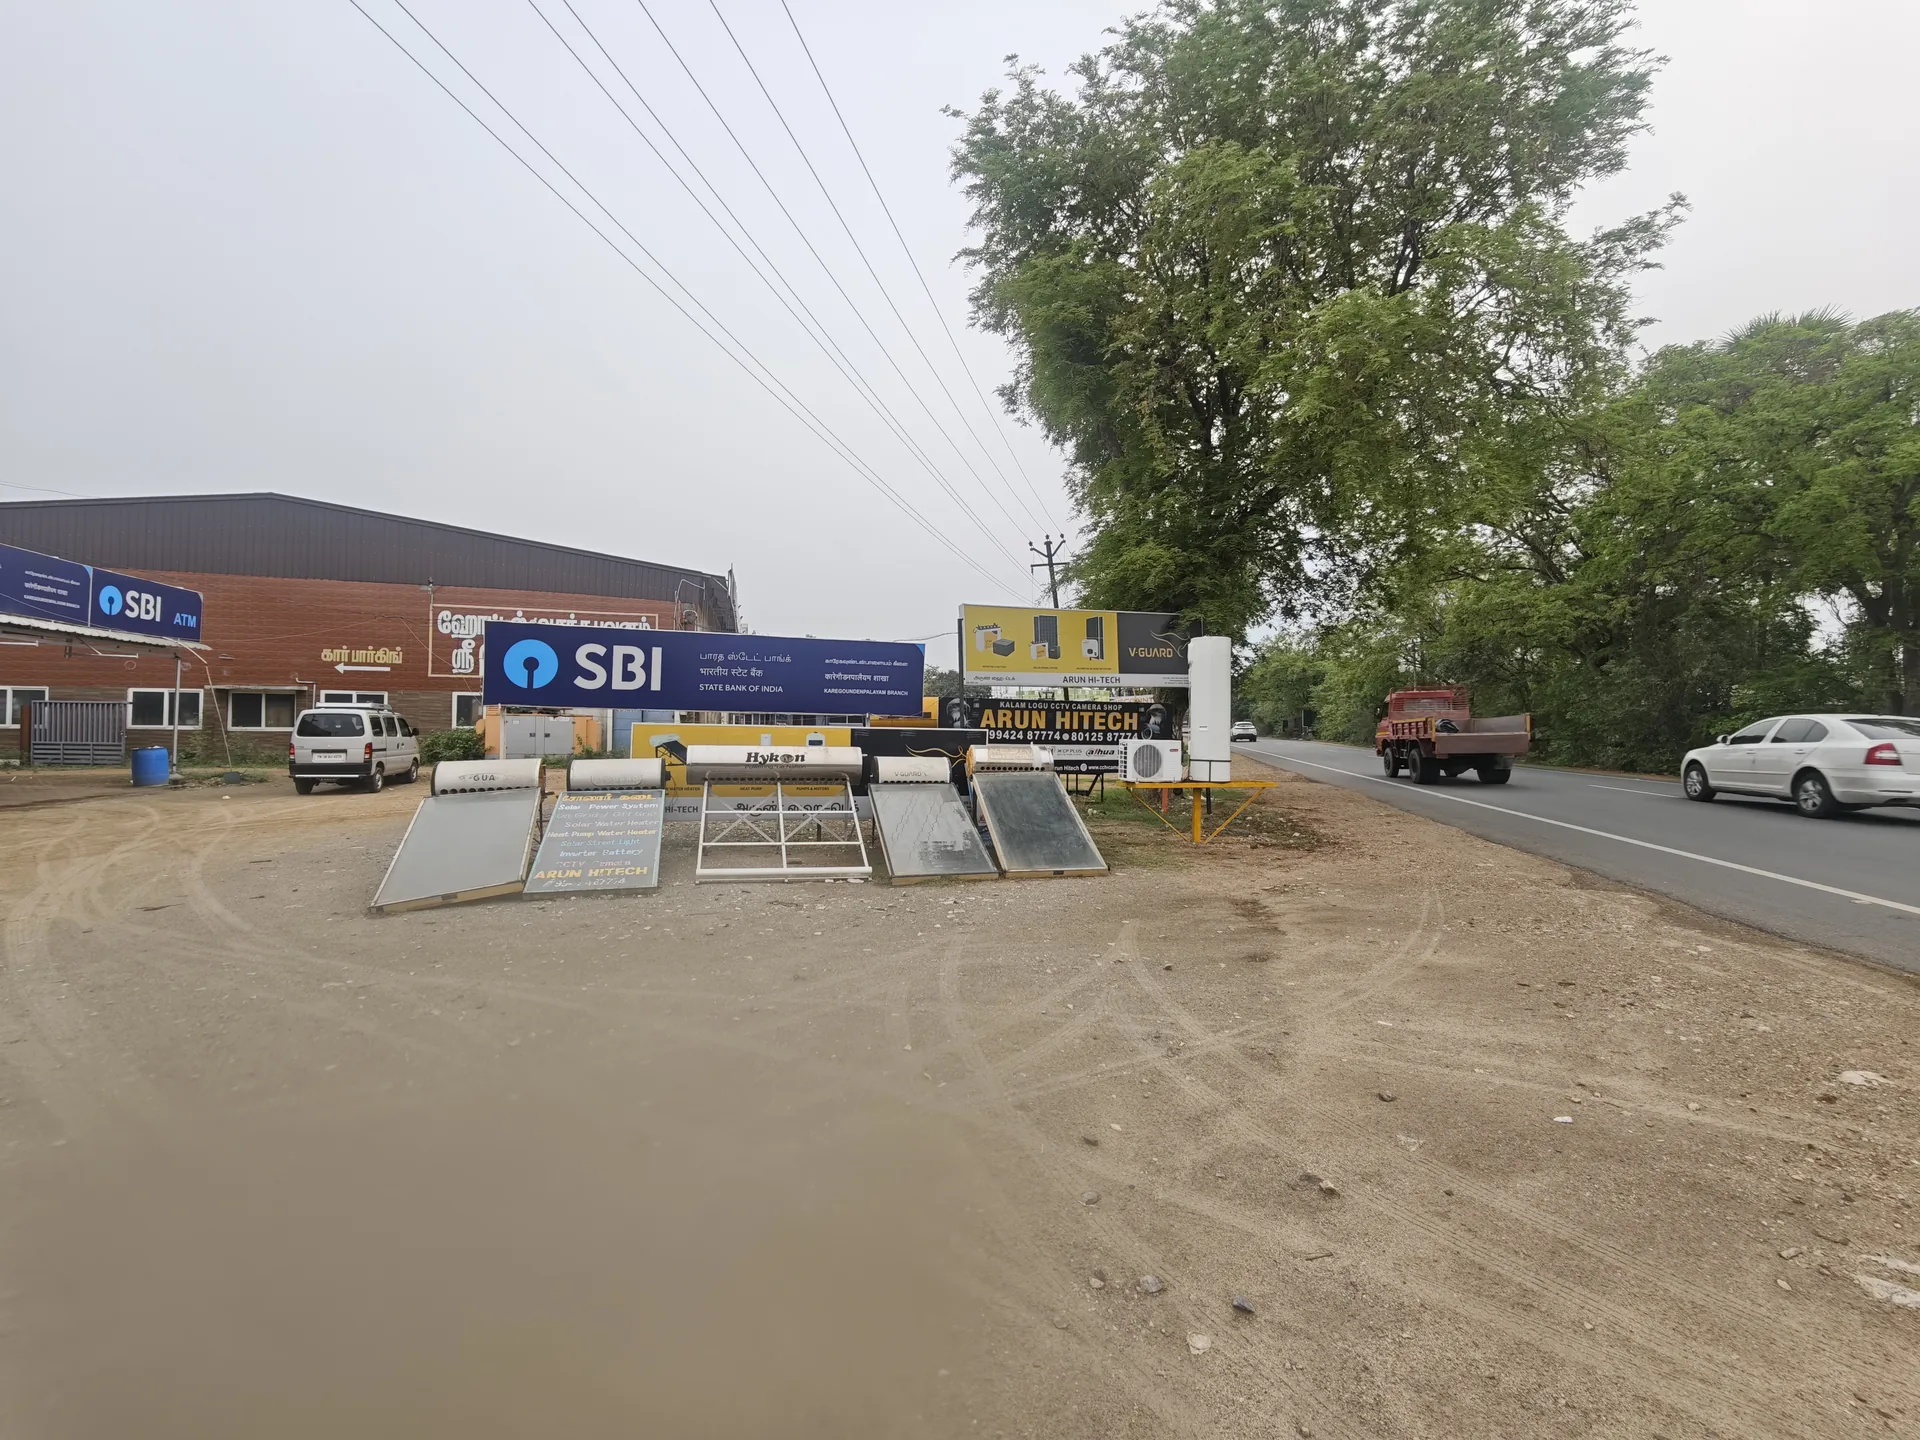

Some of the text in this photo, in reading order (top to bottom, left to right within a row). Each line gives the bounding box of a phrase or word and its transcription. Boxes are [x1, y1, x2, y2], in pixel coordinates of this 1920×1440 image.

[124, 590, 161, 622] SBI
[173, 612, 197, 628] ATM
[321, 645, 350, 662] கார்
[699, 653, 725, 662] பாரத
[573, 643, 662, 691] SBI
[699, 665, 728, 677] भारतीय
[730, 666, 748, 677] स्टेट
[873, 674, 889, 682] शाखा
[1063, 675, 1121, 684] ARUN HI-TECH
[725, 684, 747, 692] BANK
[761, 685, 783, 693] INDIA
[1000, 701, 1026, 709] KALAM
[1028, 702, 1048, 710] LOGU
[1071, 703, 1101, 711] CAMERA
[979, 708, 1046, 729] ARUN
[1055, 710, 1138, 731] HITECH
[988, 729, 1024, 740] 99424
[1026, 730, 1061, 741] 87774
[1071, 731, 1104, 742] 80125
[621, 803, 659, 811] System
[602, 848, 644, 856] Battery
[533, 867, 648, 879] ARUN HITECH
